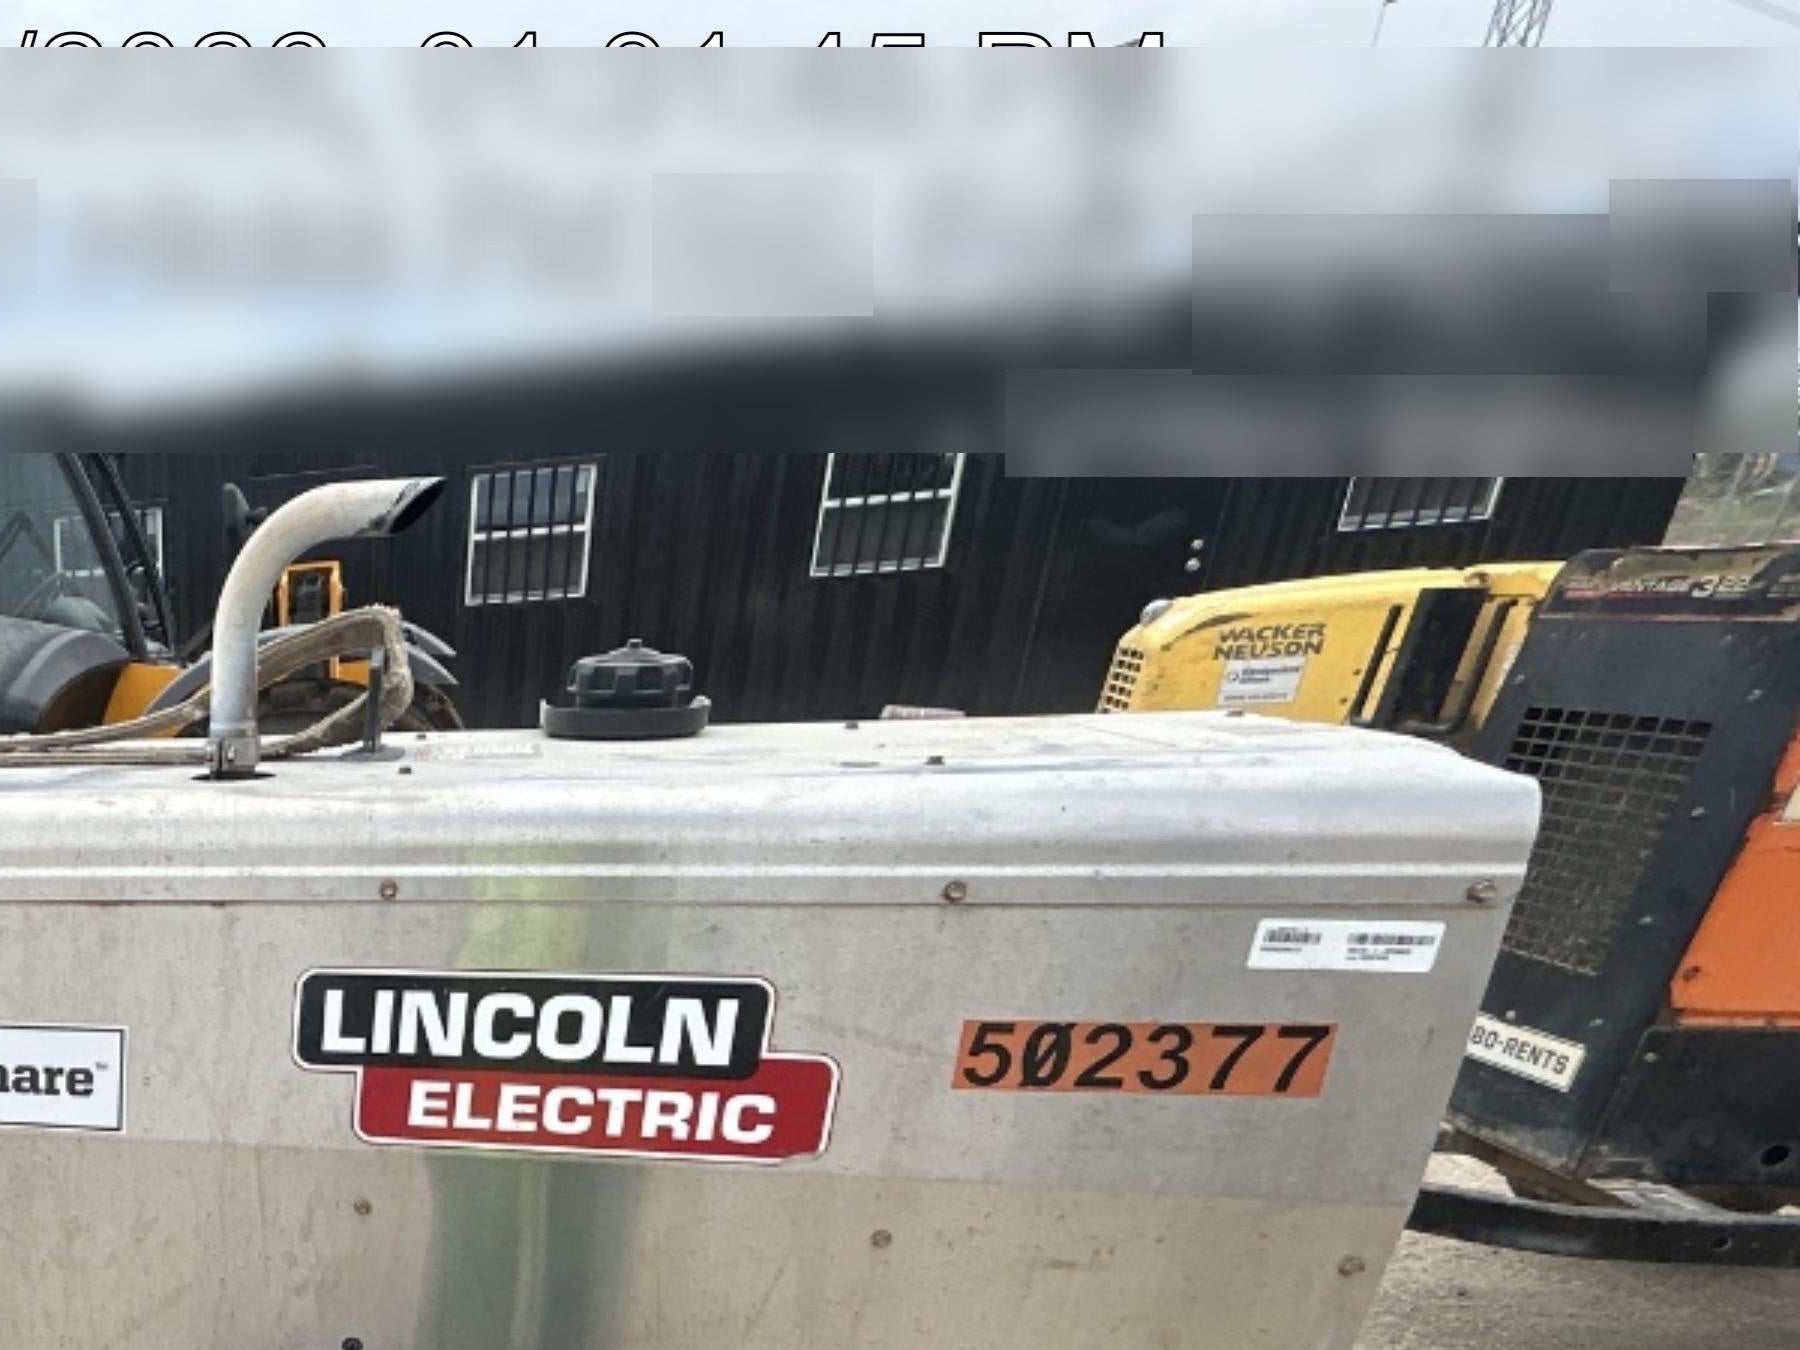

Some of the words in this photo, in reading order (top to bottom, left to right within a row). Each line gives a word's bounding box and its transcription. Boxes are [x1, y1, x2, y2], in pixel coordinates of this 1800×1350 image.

[1212, 639, 1325, 660] NEUSON
[1220, 622, 1326, 643] WACKER
[321, 989, 739, 1066] LINCOLN
[962, 1022, 1331, 1092] 502377
[407, 1079, 777, 1144] ELECTRIC
